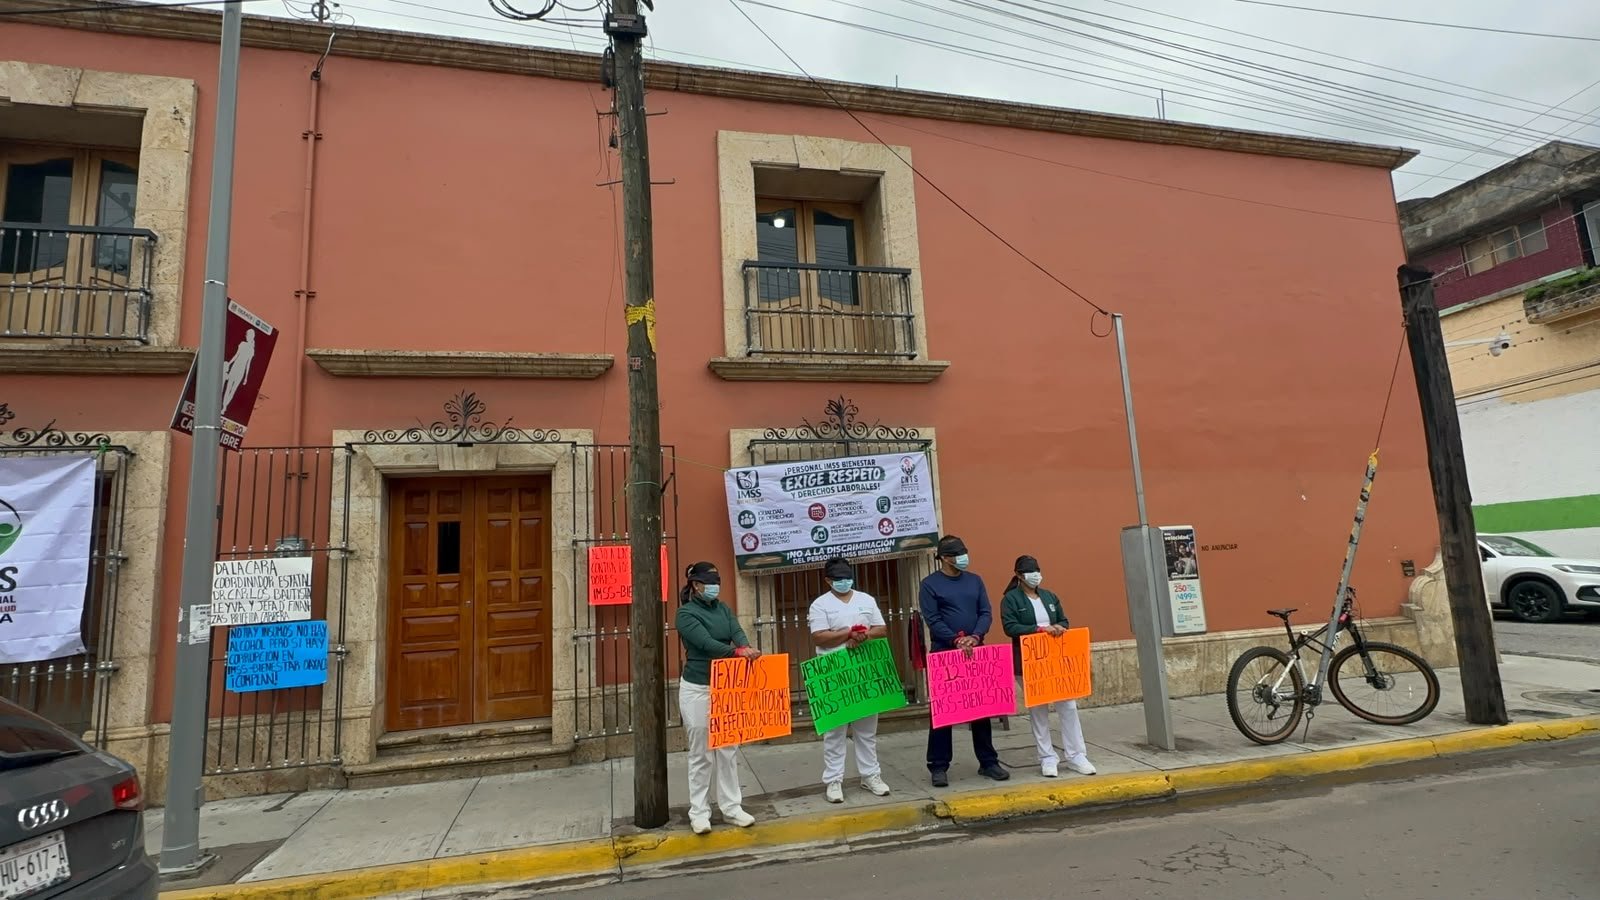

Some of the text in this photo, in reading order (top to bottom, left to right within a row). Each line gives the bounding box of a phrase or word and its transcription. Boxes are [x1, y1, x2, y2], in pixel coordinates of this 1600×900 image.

[220, 433, 240, 449] IBRE
[785, 459, 876, 476] ¡PERSONAL IMSS BIENESTAR
[785, 468, 880, 491] EXIGE RESPETO
[738, 489, 762, 499] IMSS
[798, 486, 835, 498] DERECHOS
[837, 483, 880, 492] LABORALES!
[787, 550, 803, 560] ¡NO
[827, 538, 895, 554] DISCRIMINACIÓN
[231, 562, 244, 575] LA
[246, 560, 277, 576] CARA
[214, 576, 274, 589] COORDINADOR
[228, 588, 270, 600] CARLOS
[593, 585, 632, 600] IMSS-BIE
[213, 602, 246, 613] LEYVA
[249, 600, 254, 611] Y
[297, 624, 308, 637] NO
[310, 624, 327, 637] HAY
[230, 639, 265, 652] ALCOHOL
[306, 638, 325, 649] HAY
[1022, 634, 1049, 661] SALUD
[282, 650, 294, 661] EN
[944, 664, 964, 682] 12
[711, 692, 733, 714] PAGO
[735, 691, 746, 712] DE
[710, 716, 720, 733] EN
[746, 727, 764, 740] 2026
